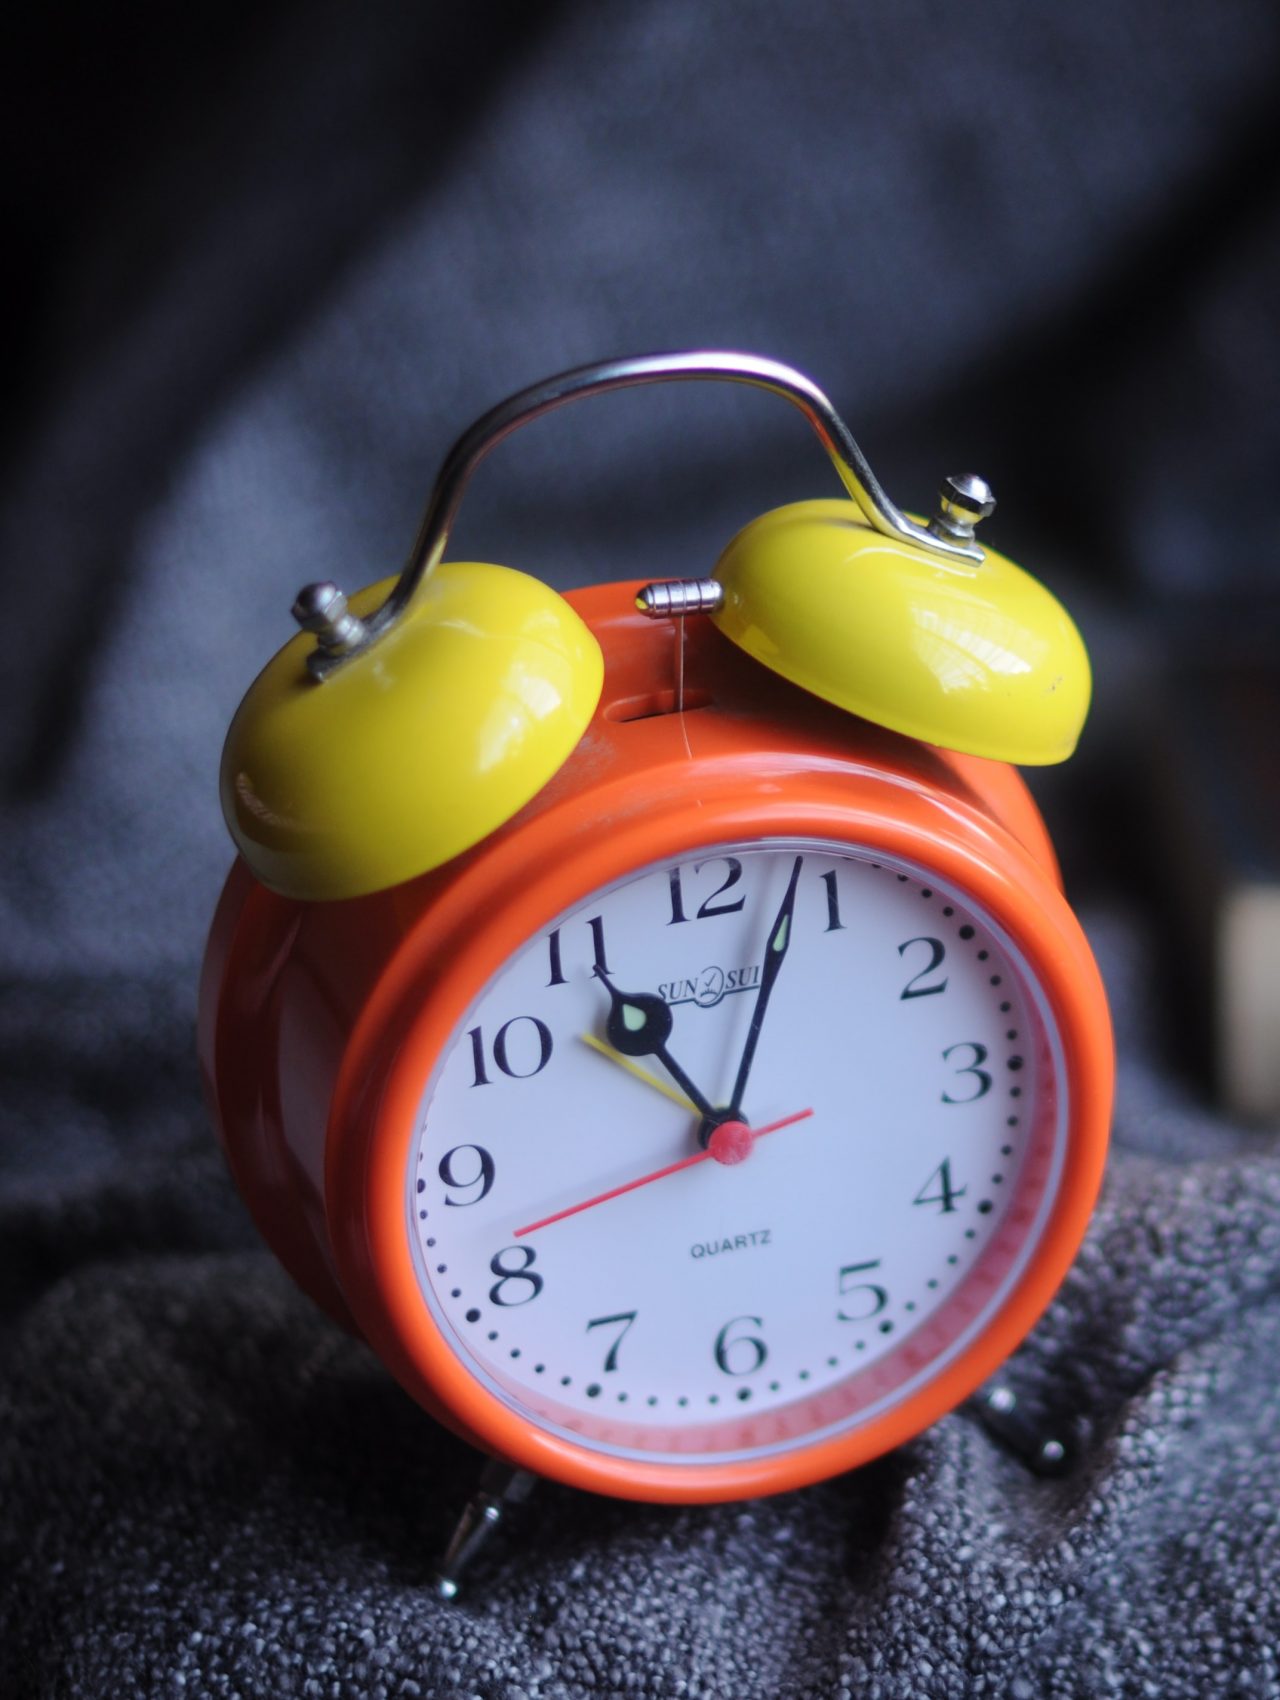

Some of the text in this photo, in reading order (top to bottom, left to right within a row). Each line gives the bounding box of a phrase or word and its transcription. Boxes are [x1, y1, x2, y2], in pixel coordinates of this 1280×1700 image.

[666, 856, 746, 925] 12
[820, 869, 846, 933] 1
[545, 915, 616, 988] 11
[898, 936, 948, 1001] 2
[657, 977, 699, 1001] SUN
[467, 1015, 554, 1088] 10
[941, 1042, 993, 1104] 3
[437, 1144, 496, 1208] 9
[912, 1157, 967, 1214] 4
[488, 1244, 545, 1308] 8
[690, 1229, 771, 1259] QUARTZ
[836, 1258, 889, 1323] 5
[586, 1310, 638, 1374] 7
[713, 1315, 769, 1377] 6
